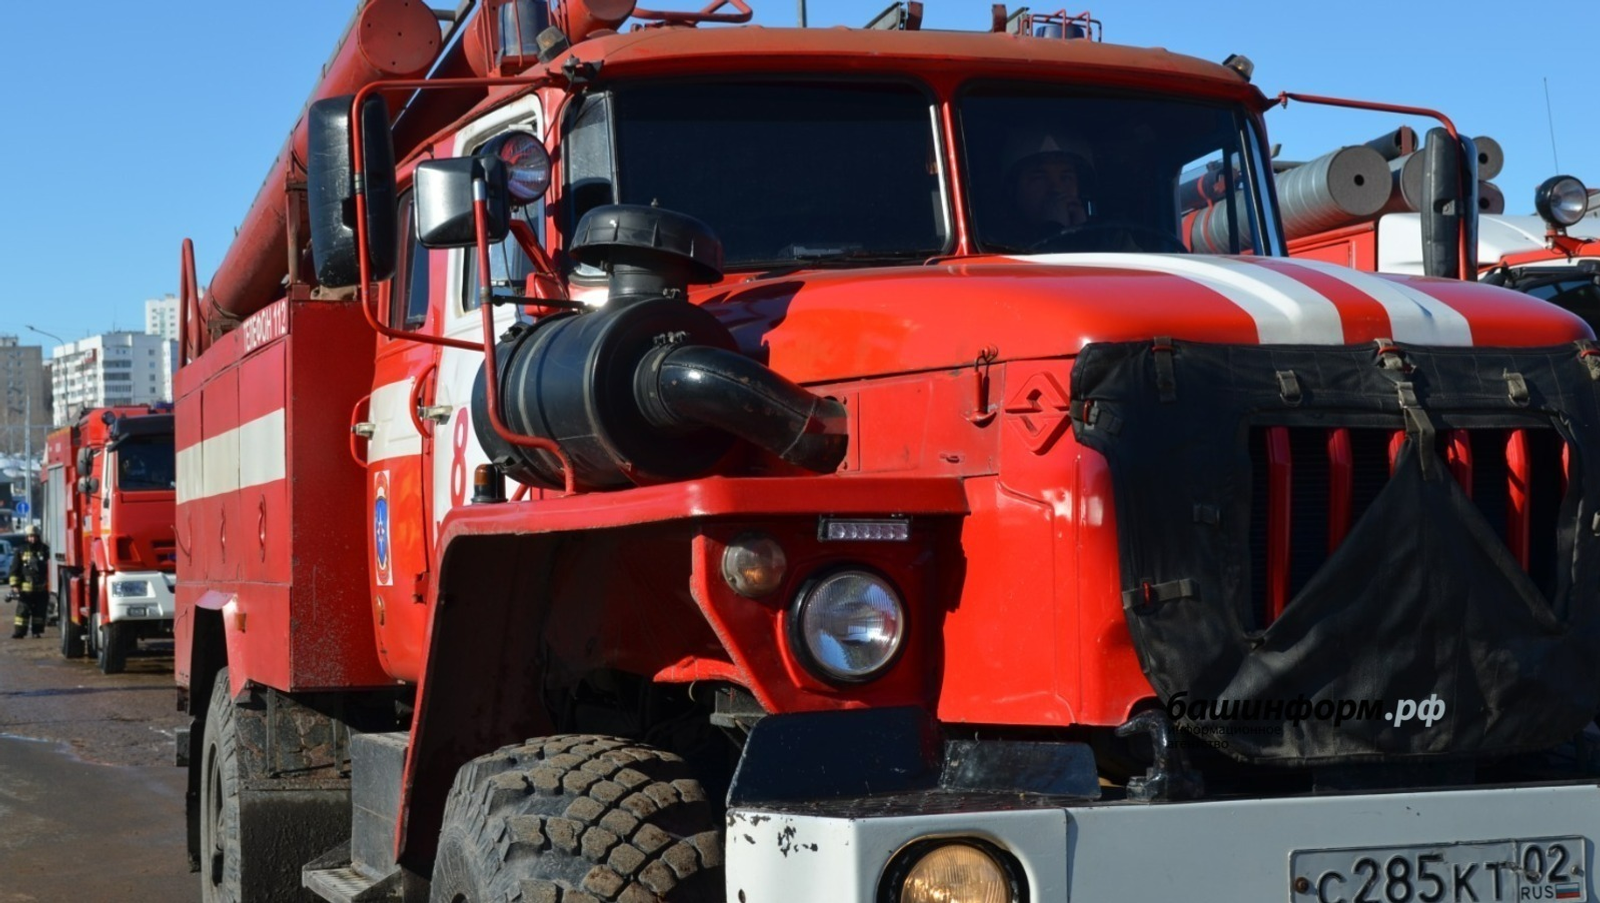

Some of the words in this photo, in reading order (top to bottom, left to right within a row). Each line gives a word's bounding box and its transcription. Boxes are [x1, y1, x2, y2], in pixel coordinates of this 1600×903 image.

[273, 300, 286, 337] 112
[1522, 843, 1570, 883] 02
[1520, 885, 1555, 900] RUS
